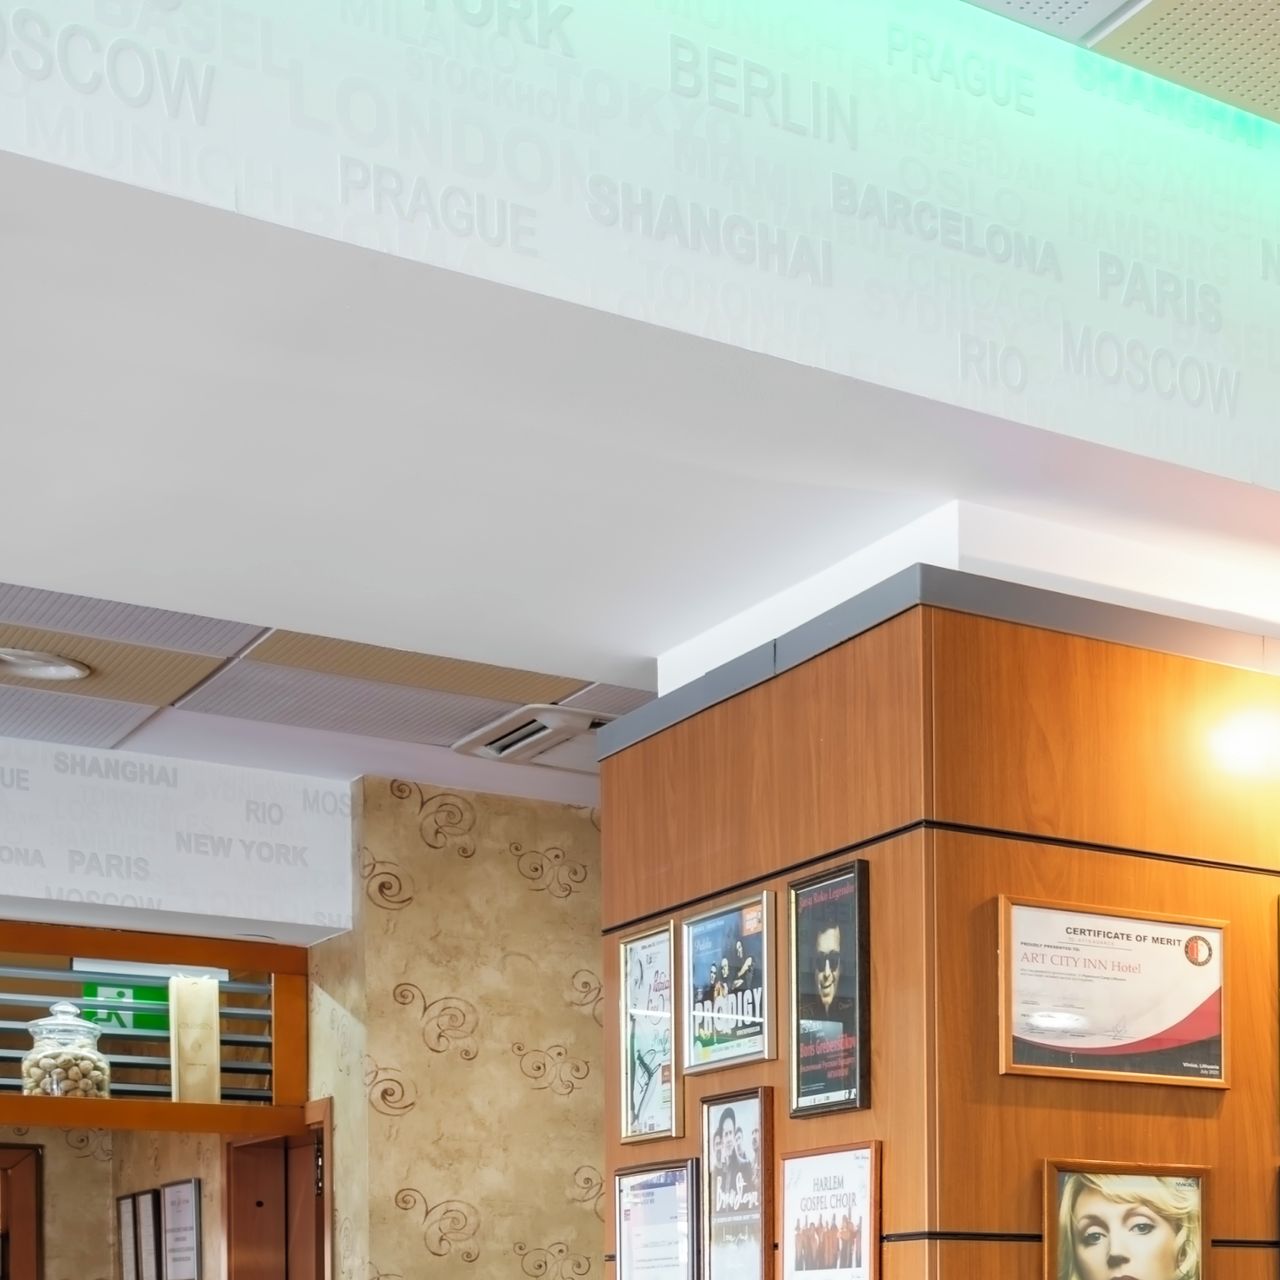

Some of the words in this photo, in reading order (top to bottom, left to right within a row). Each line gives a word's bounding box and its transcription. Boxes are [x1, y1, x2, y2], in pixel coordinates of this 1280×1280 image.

[0, 7, 217, 126] SCOW
[668, 33, 860, 151] BERLIN
[886, 21, 1037, 117] PRAGUE
[338, 154, 541, 257] PRAGUE
[585, 172, 834, 288] SHANGHAI
[831, 171, 1065, 283] BARCELONA
[1097, 248, 1225, 335] PARIS
[957, 331, 1030, 396] RIO
[1060, 318, 1243, 421] MOSCOW
[53, 751, 179, 788] SHANGHAI
[245, 798, 285, 827] RIO
[67, 849, 151, 881] PARIS
[175, 830, 234, 860] NEW
[239, 837, 309, 869] YORK
[1020, 952, 1047, 965] ART
[1050, 953, 1081, 968] CITY
[1083, 957, 1108, 971] INN
[1111, 961, 1143, 974] Hotel
[1065, 926, 1133, 942] CERTIFICATE
[1135, 934, 1149, 944] OF
[1151, 936, 1183, 947] MERIT
[694, 987, 763, 1036] PRODIGY
[800, 1194, 829, 1213] GOSPEL
[829, 1192, 858, 1210] CHOIR
[812, 1175, 845, 1193] HARLEM
